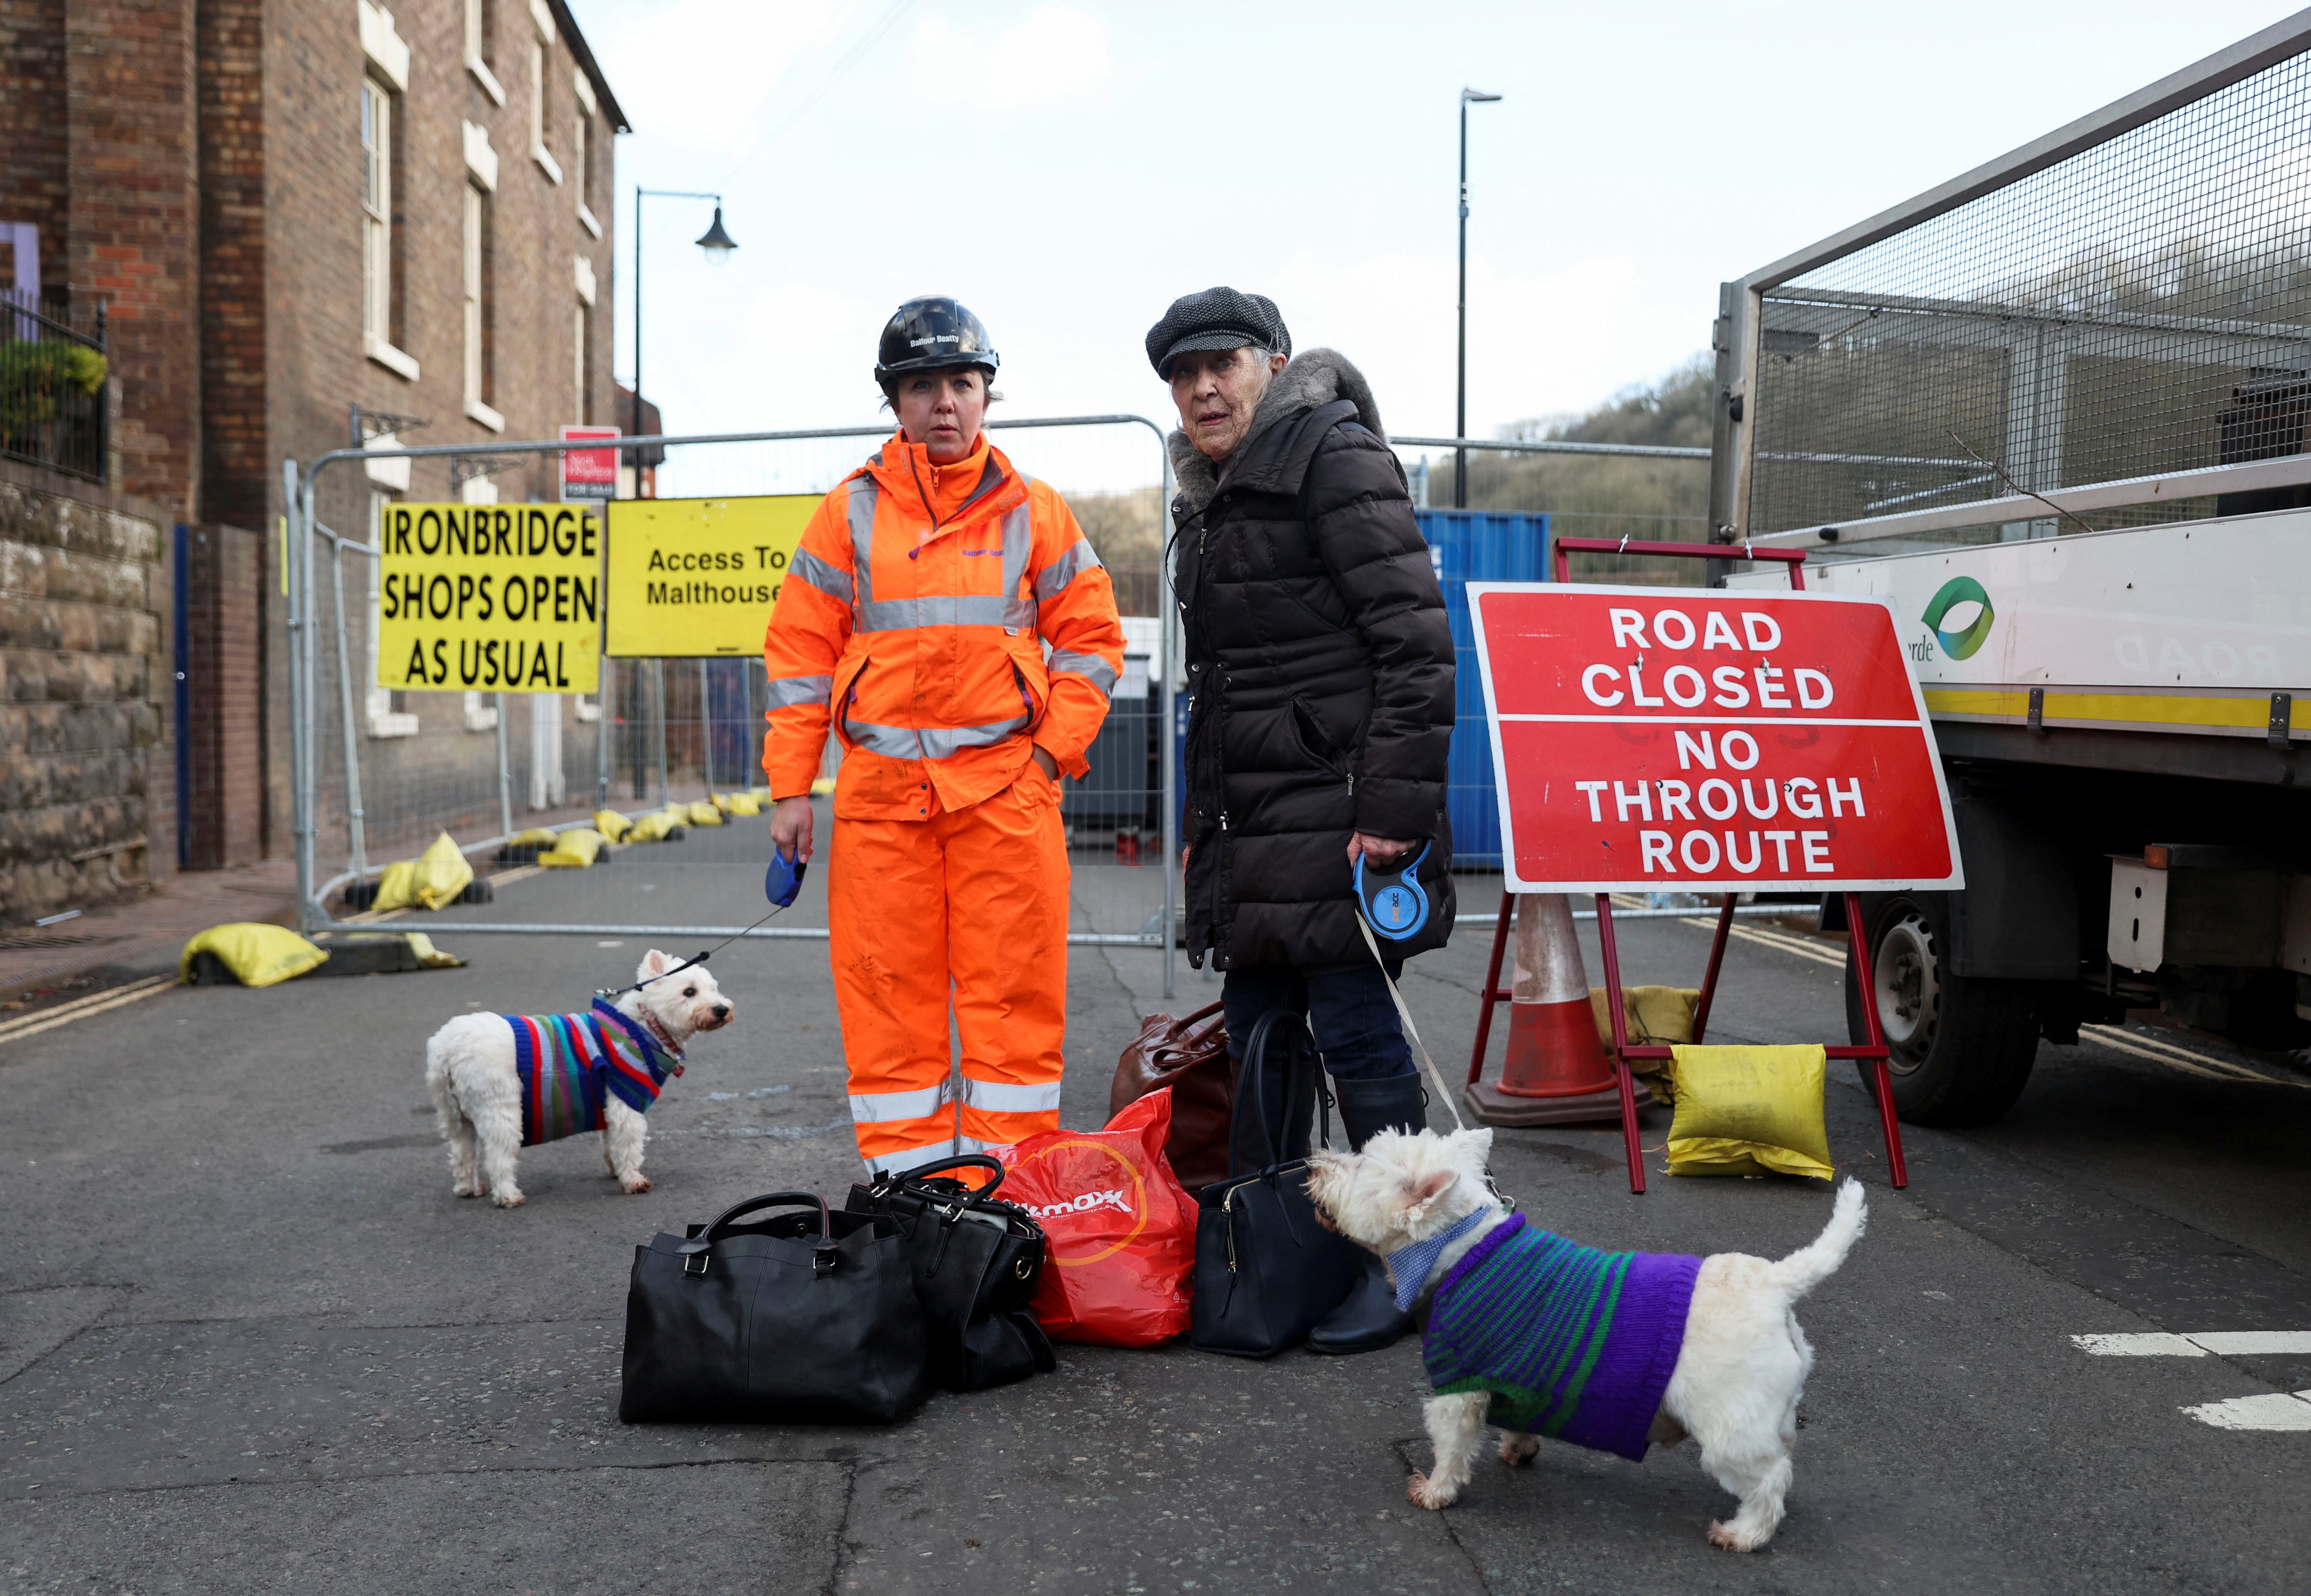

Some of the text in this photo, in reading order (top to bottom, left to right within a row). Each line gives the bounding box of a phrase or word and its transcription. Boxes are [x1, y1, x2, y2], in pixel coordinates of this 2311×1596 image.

[910, 334, 959, 348] Balfour Beatty
[386, 510, 596, 557] IRONBRIDGE
[963, 549, 988, 557] Balfour
[649, 547, 785, 570] Access To
[384, 574, 596, 622] SHOPS OPEN
[1608, 608, 1782, 652] ROAD
[406, 639, 569, 687] AS USUAL
[1581, 663, 1834, 709] CLOSED
[1674, 729, 1760, 771] NO
[1575, 776, 1866, 822] THROUGH
[1639, 829, 1835, 874] ROUTE
